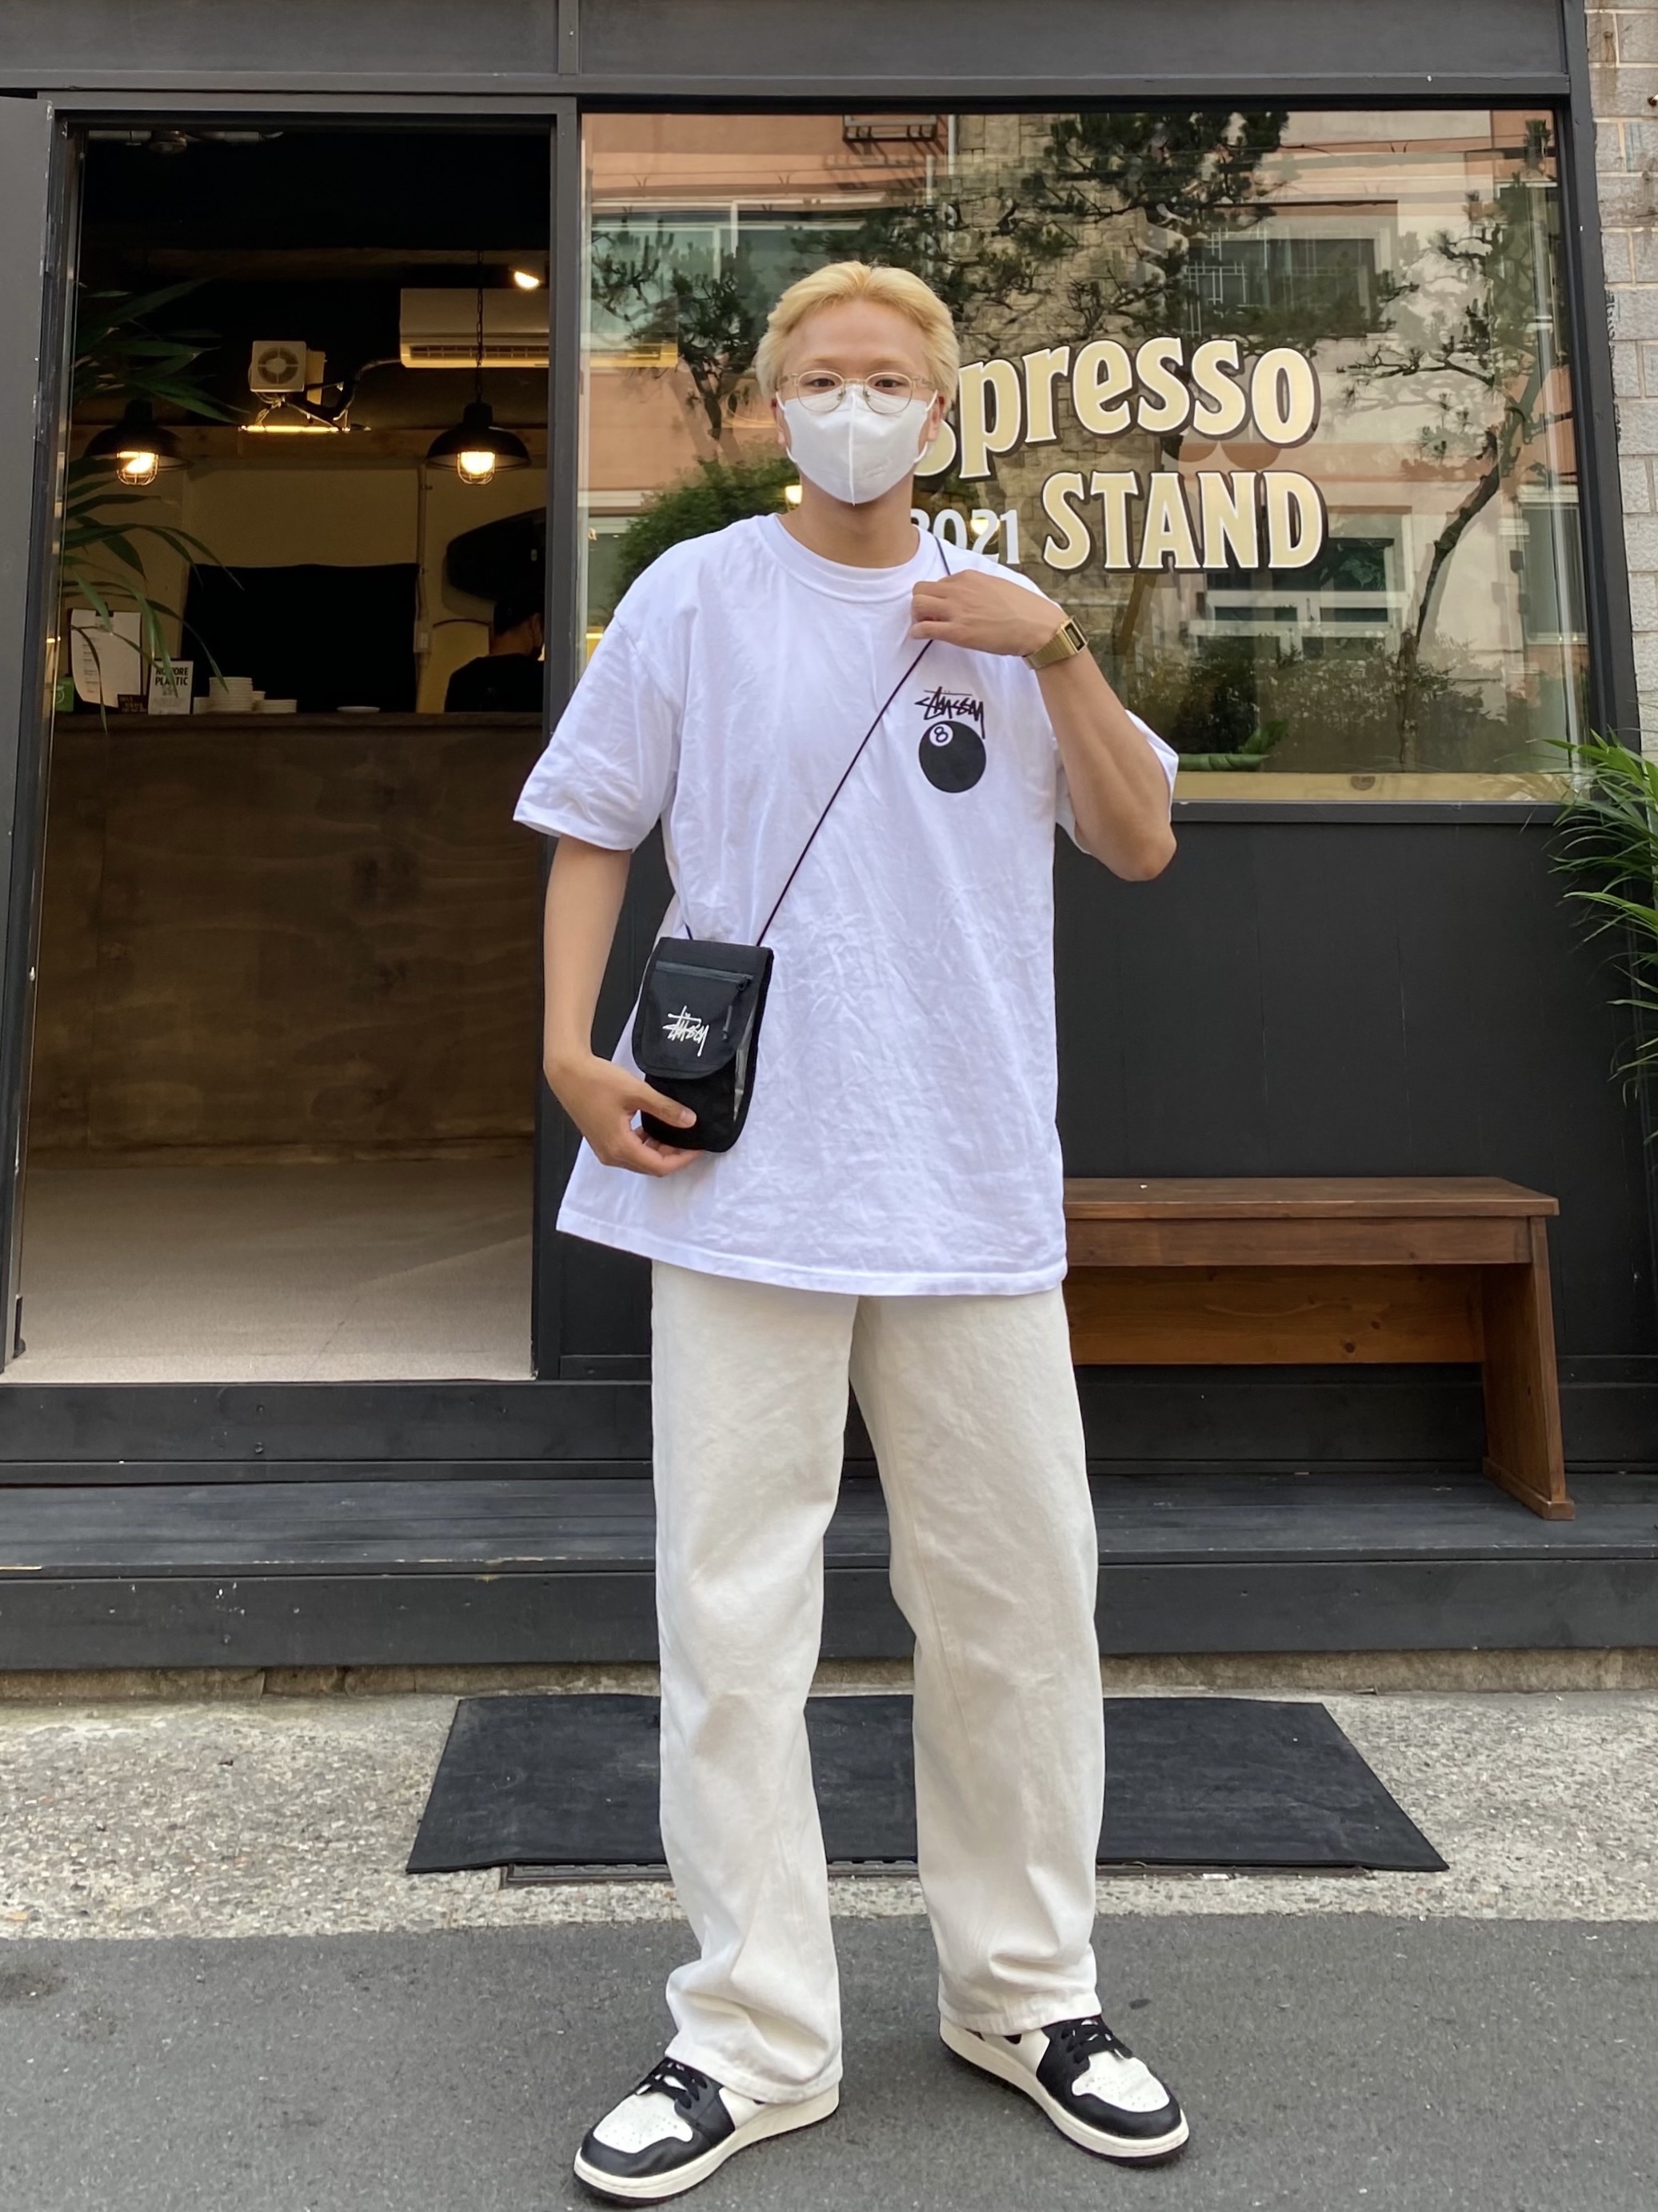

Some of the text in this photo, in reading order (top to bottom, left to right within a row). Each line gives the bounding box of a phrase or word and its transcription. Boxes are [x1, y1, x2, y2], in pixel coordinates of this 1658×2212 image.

[1042, 470, 1324, 571] STAND
[170, 667, 189, 676] ORE
[154, 677, 189, 686] PLATIC
[933, 725, 949, 743] 8
